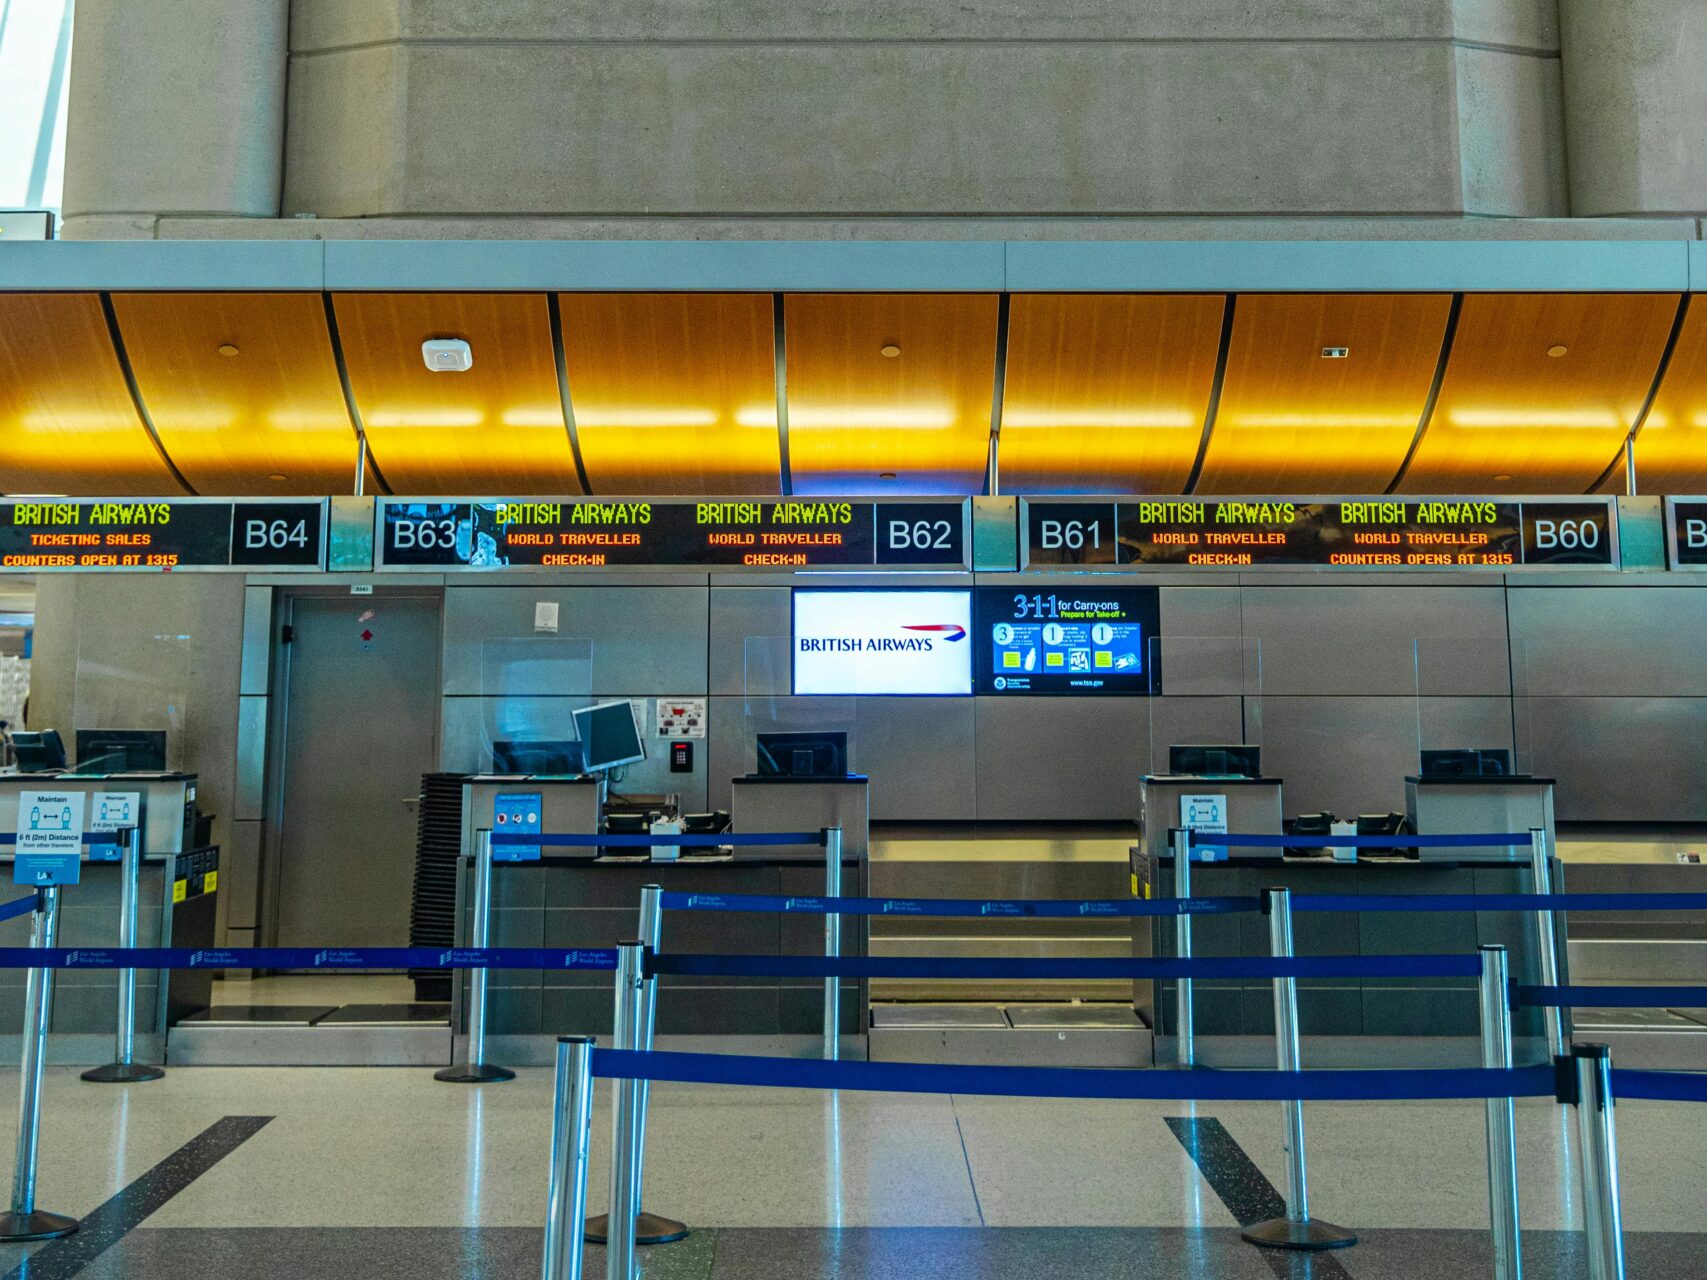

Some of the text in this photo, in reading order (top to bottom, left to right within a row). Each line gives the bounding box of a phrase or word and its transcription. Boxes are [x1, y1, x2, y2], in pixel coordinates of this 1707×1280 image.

[13, 504, 171, 525] BRITISH AIRWAYS
[495, 503, 651, 524] BRITISH AIRWAYS
[696, 503, 852, 524] BRITISH AIRWAYS
[1139, 502, 1295, 524] BRITISH AIRWAYS
[1341, 502, 1497, 524] BRITISH AIRWAYS
[31, 534, 151, 546] TICKETING SALES
[246, 520, 308, 549] B64
[394, 520, 456, 549] B63
[507, 533, 640, 545] WORLD TRAVELLER
[708, 533, 842, 545] WORLD TRAVELLER
[889, 520, 952, 549] B62
[1041, 520, 1100, 549] B61
[1153, 533, 1286, 544] WORLD TRAVELLER
[1354, 533, 1488, 545] WORLD TRAVELLER
[1535, 520, 1599, 549] B60
[3, 555, 178, 567] COUNTERS OPEN AT 1315
[542, 554, 605, 566] CHECK-IN
[744, 554, 807, 565] CHECK-IN
[1188, 554, 1251, 565] CHECK-IN
[1330, 554, 1513, 565] COUNTERS OPENS AT 1315
[1014, 594, 1119, 618] 3-1-1 for Carry-ons
[1060, 611, 1085, 619] Prepare
[999, 627, 1007, 641] 3
[1050, 627, 1055, 641] 1
[1100, 627, 1105, 641] 1
[800, 639, 933, 652] BRITISH AIRWAYS
[38, 795, 67, 803] Maintain
[32, 834, 47, 842] (2m)
[37, 872, 53, 880] LAX
